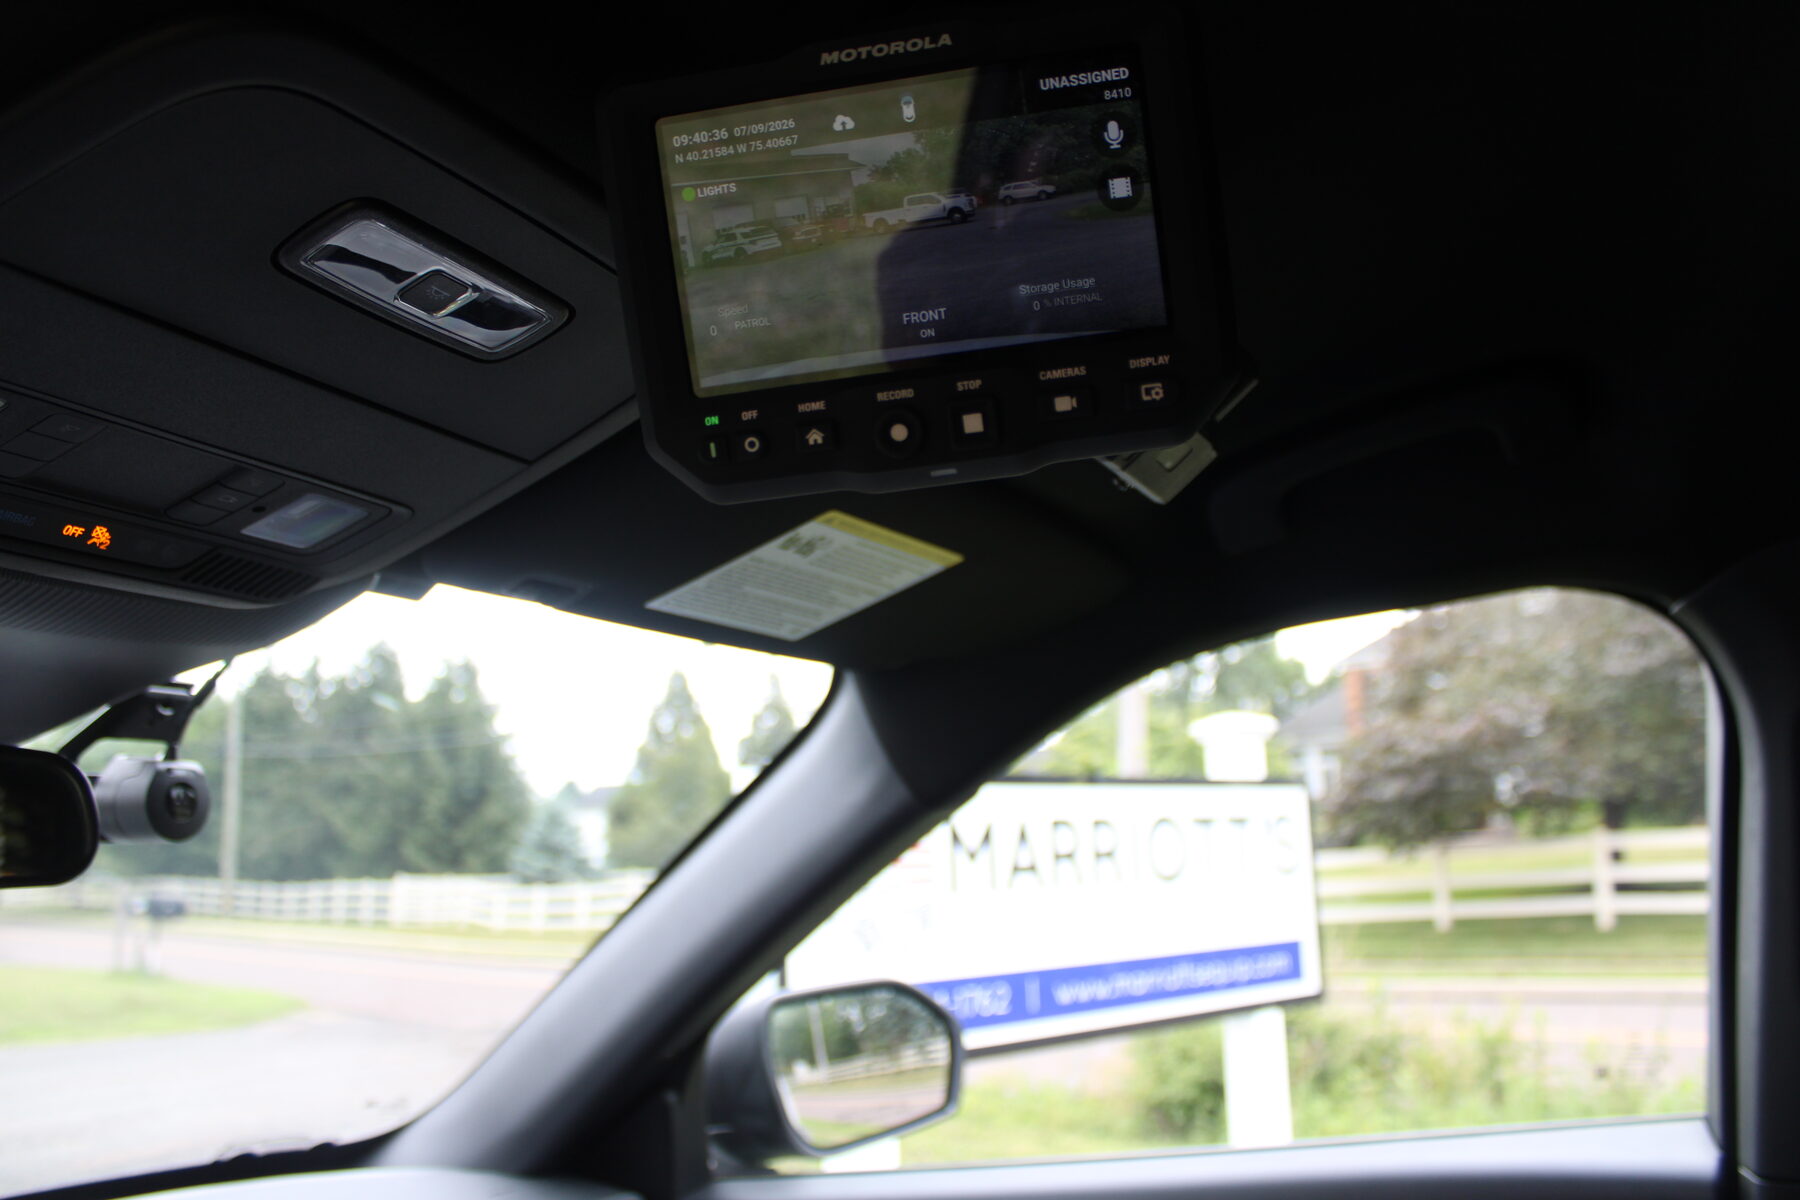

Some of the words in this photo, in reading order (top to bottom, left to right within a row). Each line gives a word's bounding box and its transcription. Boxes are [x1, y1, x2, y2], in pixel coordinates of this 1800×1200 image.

[820, 33, 952, 65] MOTOROLA
[1039, 67, 1129, 91] UNASSIGNED
[1104, 87, 1132, 100] 8410
[672, 128, 729, 148] 09:40:36
[733, 118, 796, 137] 07/09/2026
[675, 153, 684, 164] N
[686, 145, 735, 162] 40.21584
[736, 143, 747, 153] W
[749, 134, 799, 152] 75.40667
[697, 183, 737, 198] LIGHTS
[1019, 282, 1060, 295] Storage
[1062, 277, 1096, 289] Usage
[1053, 292, 1103, 307] INTERNAL
[718, 304, 749, 318] Speed
[902, 307, 947, 324] FRONT
[709, 325, 718, 336] 0
[734, 317, 771, 329] PATROL
[920, 328, 936, 338] ON
[1128, 354, 1171, 369] DISPLAY
[1039, 366, 1087, 381] CAMERAS
[956, 379, 982, 391] STOP
[876, 388, 914, 402] RECORD
[797, 401, 827, 413] HOME
[704, 415, 720, 426] ON
[740, 410, 759, 421] OFF
[61, 524, 87, 538] OFF
